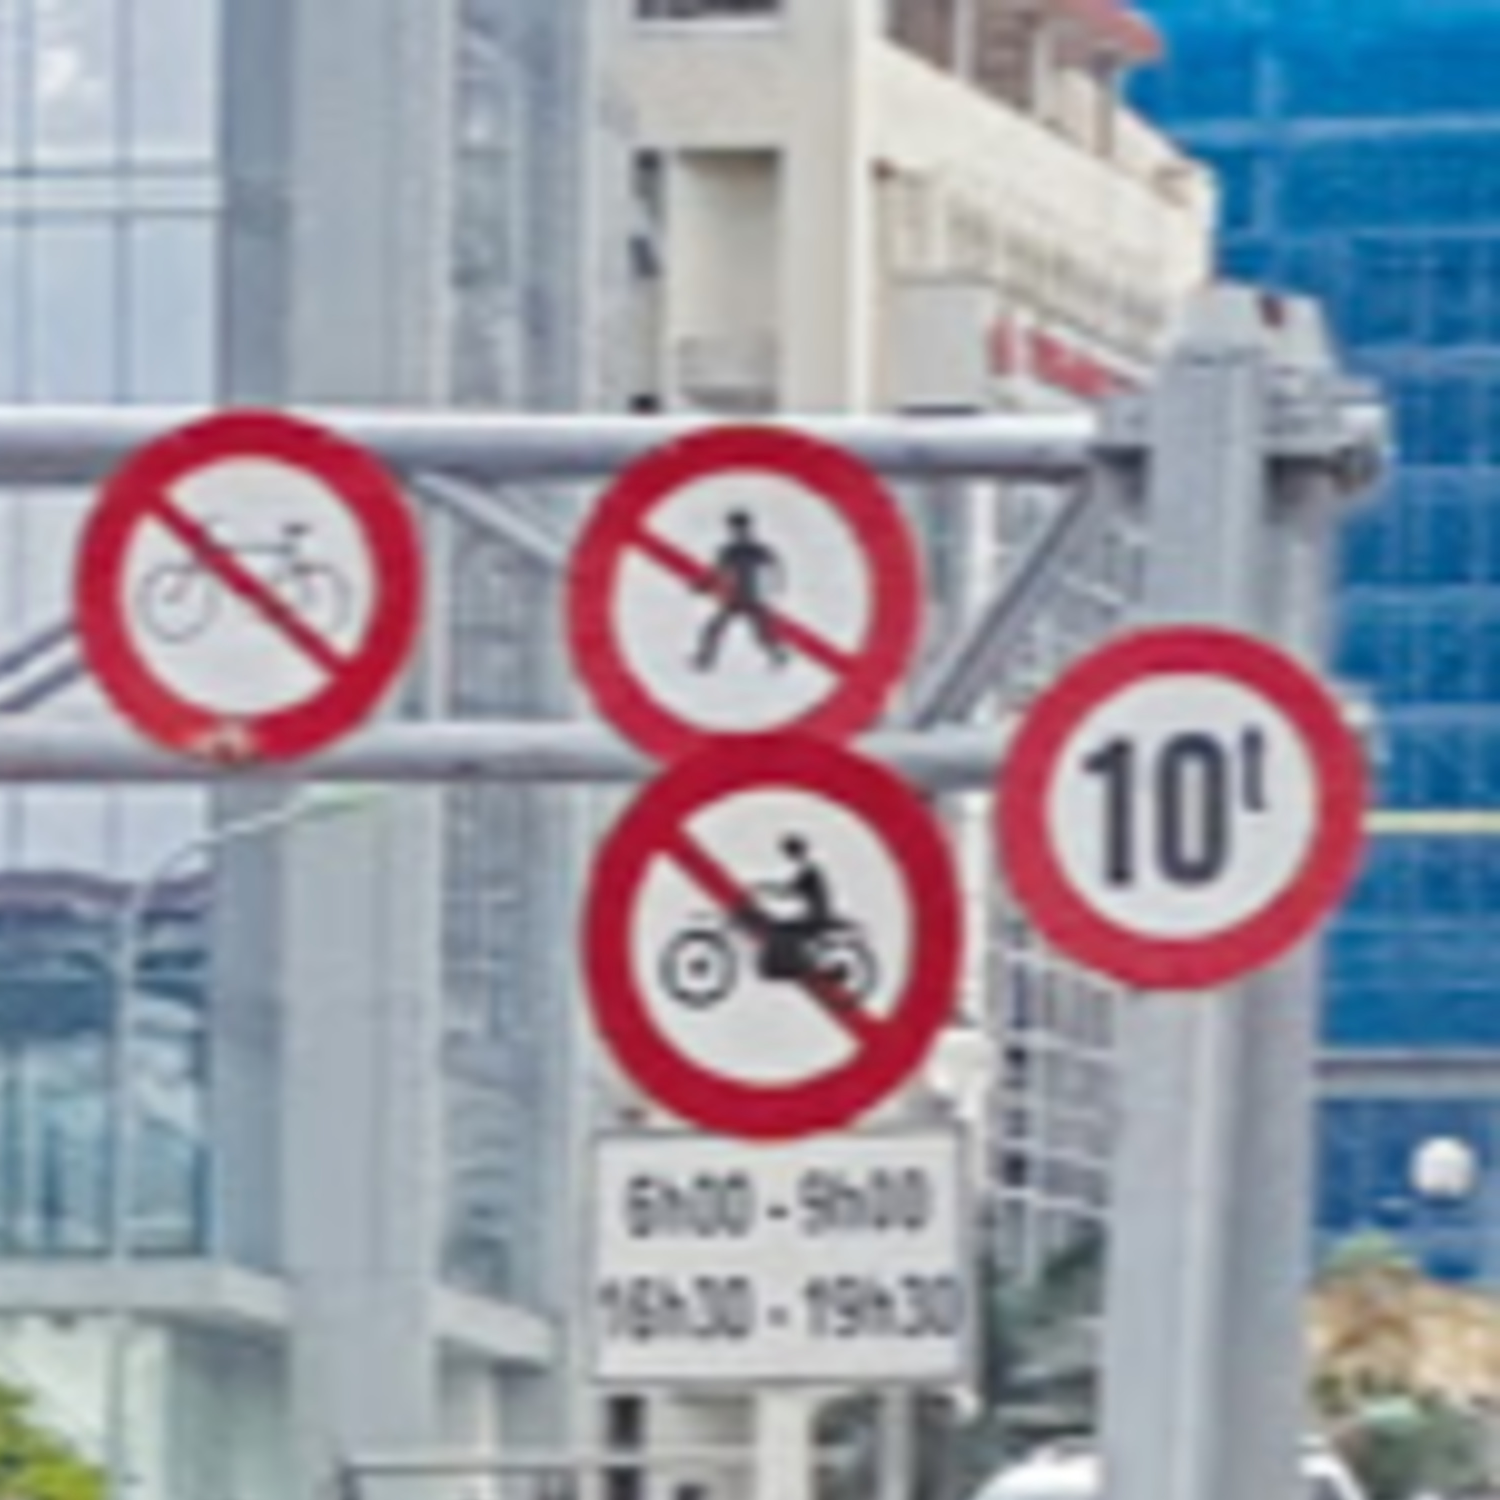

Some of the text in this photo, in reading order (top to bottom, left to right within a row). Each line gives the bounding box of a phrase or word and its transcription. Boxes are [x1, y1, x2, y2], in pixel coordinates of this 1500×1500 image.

[626, 1172, 755, 1238] 6h00
[800, 1168, 931, 1234] 9h00
[804, 1275, 965, 1339] 19h30
